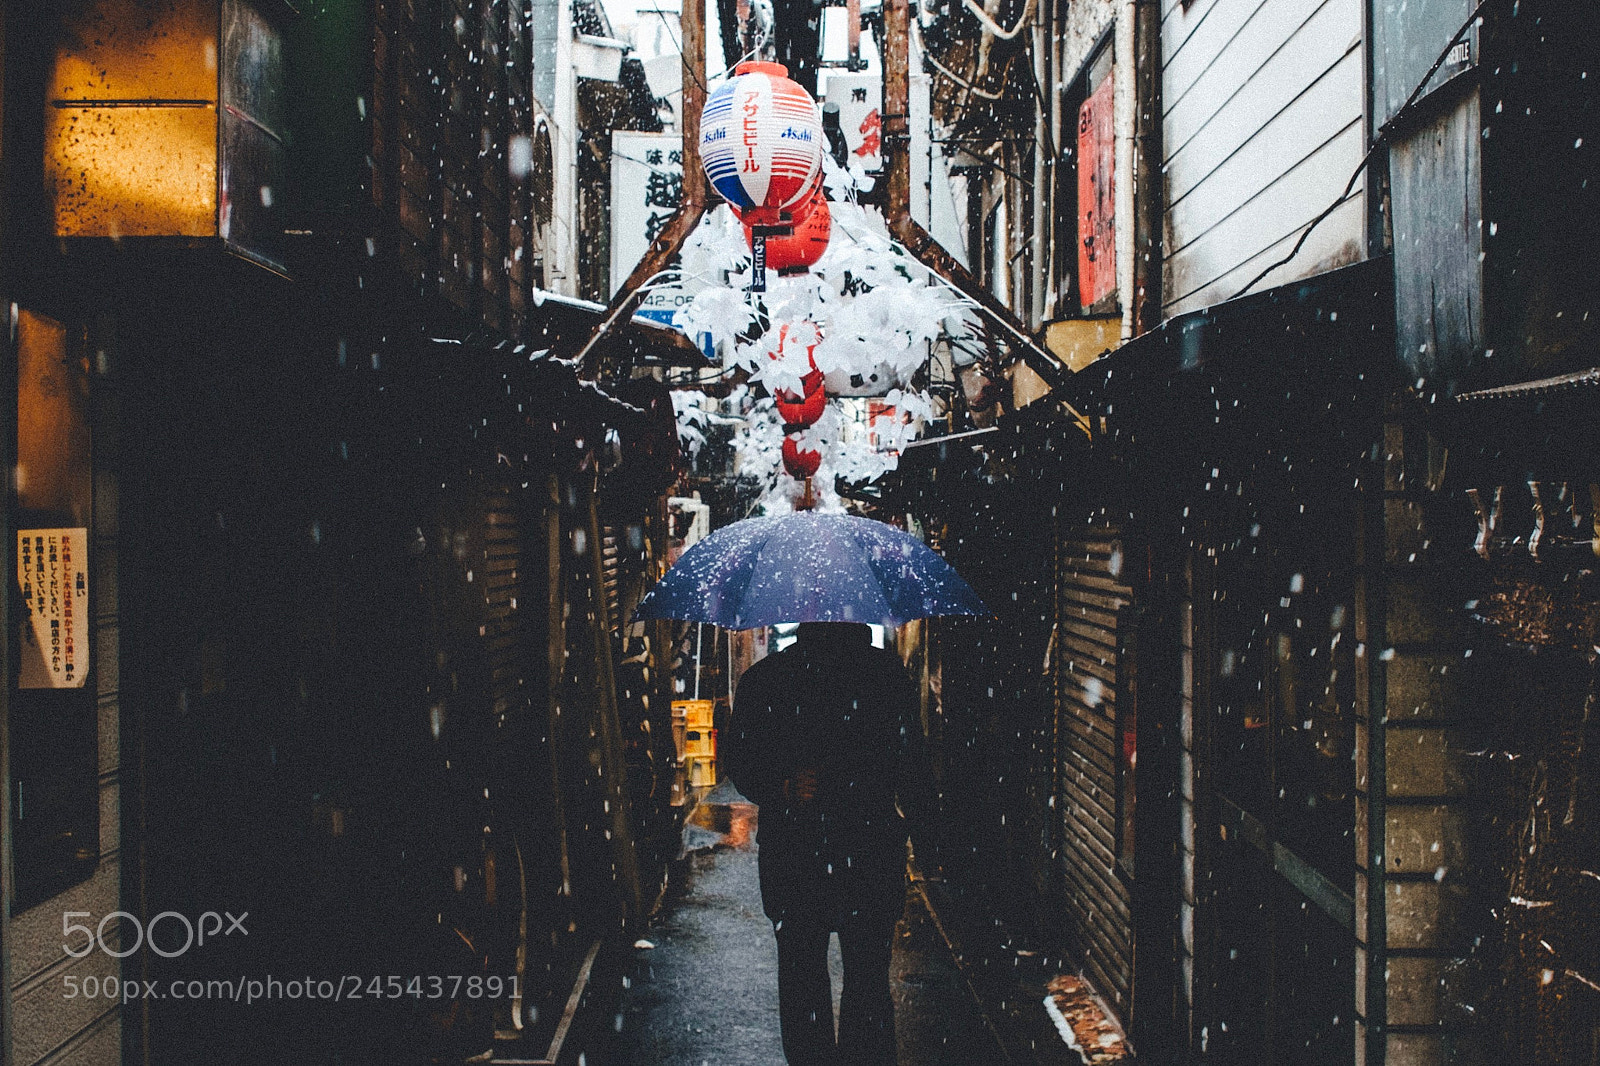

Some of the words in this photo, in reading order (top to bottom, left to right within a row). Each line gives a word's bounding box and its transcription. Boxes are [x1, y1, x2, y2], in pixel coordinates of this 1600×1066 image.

[743, 91, 760, 173] アサヒビール
[781, 126, 812, 142] Asahi
[753, 236, 765, 287] アサヒビール
[75, 571, 86, 597] お願い
